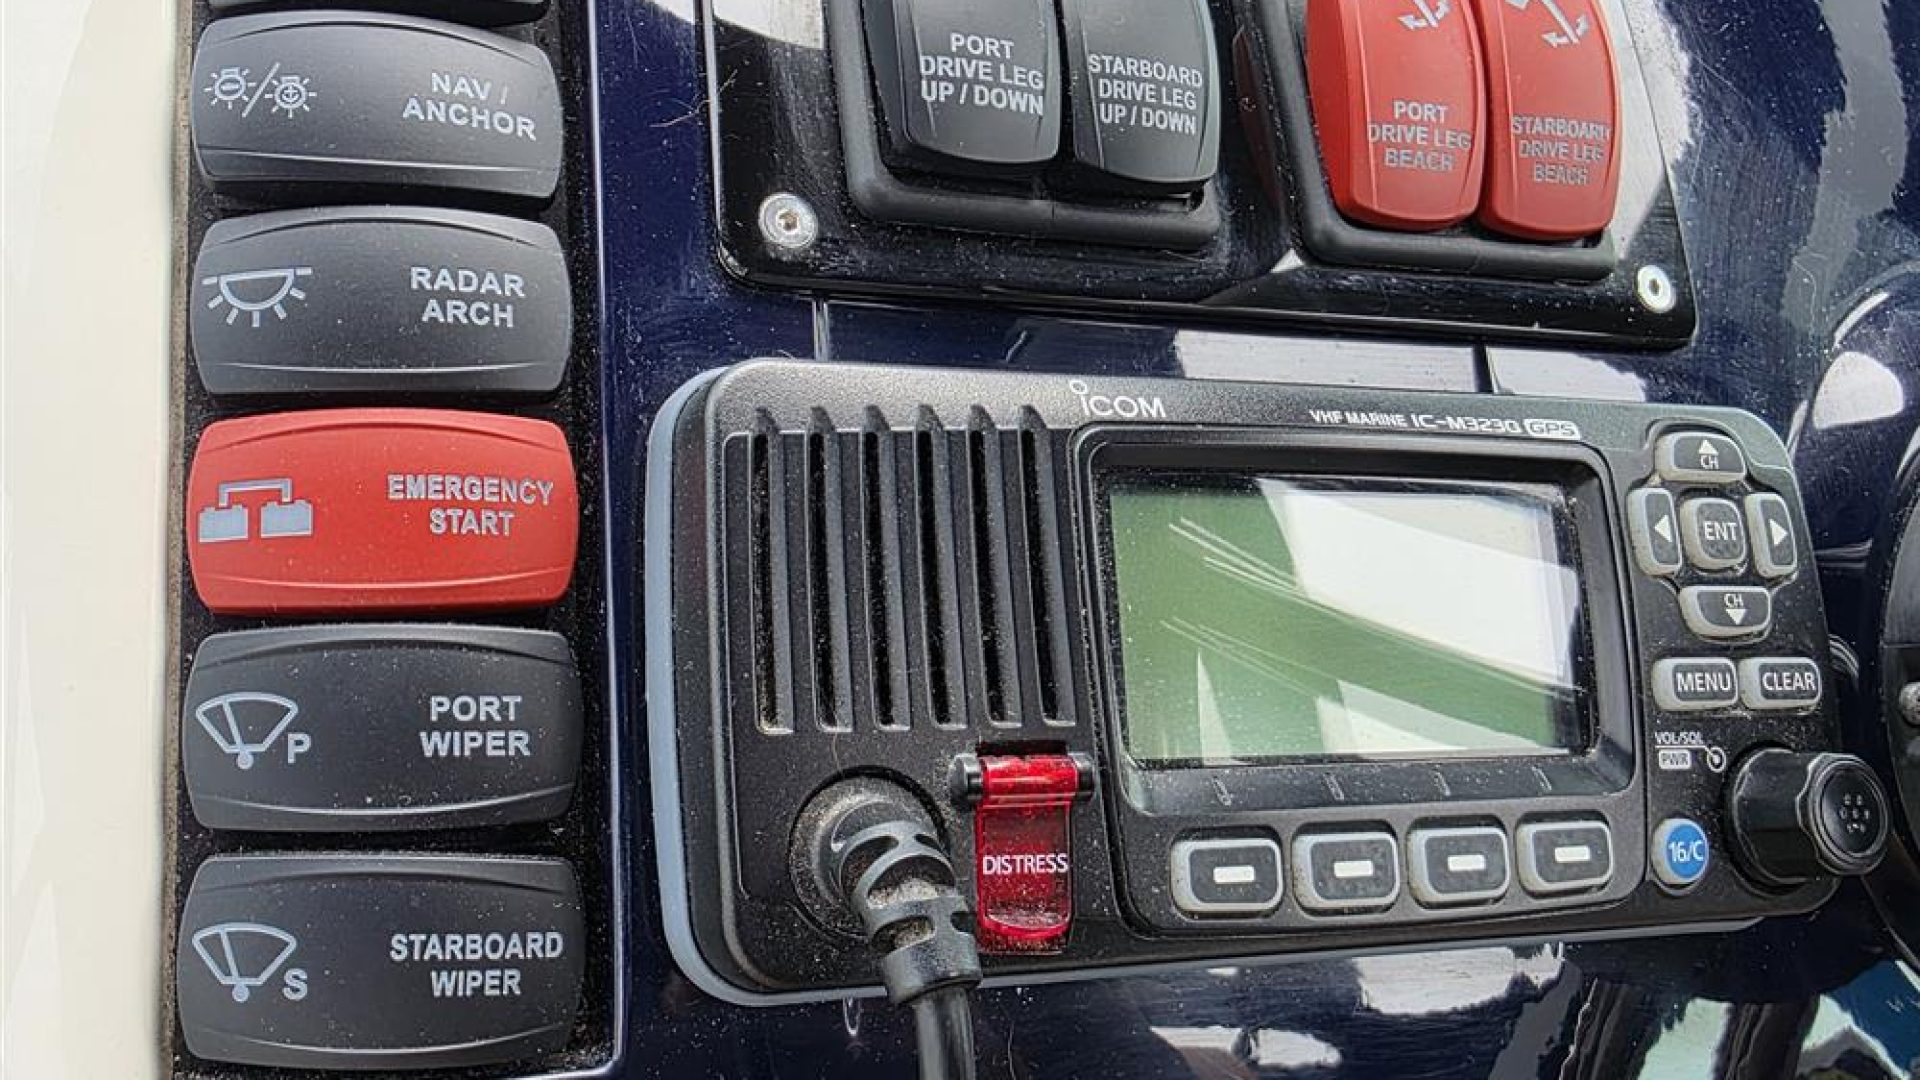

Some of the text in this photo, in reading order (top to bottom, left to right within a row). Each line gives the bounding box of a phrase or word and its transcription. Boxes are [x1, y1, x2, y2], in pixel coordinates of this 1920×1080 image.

[951, 33, 1014, 60] PORT
[919, 55, 1044, 90] DRIVE LEG
[1088, 53, 1202, 88] STARBOARD
[431, 72, 491, 99] NAV
[921, 80, 1044, 116] UP / DOWN
[1099, 78, 1197, 110] DRIVE LEG
[402, 98, 537, 141] ANCHOR
[1100, 103, 1196, 136] UP / DOWN
[1393, 101, 1448, 123] PORT
[1367, 124, 1472, 150] DRIVE LEG
[1511, 115, 1612, 142] STARBOARD
[1384, 149, 1455, 172] BEACH
[1519, 140, 1605, 161] DRIVE LEG
[1534, 165, 1589, 185] BEACH
[410, 266, 525, 297] RADAR
[422, 299, 514, 328] ARCH
[1309, 409, 1579, 438] VHF MARINE IC-M3230 GPS
[1700, 454, 1719, 469] CH
[388, 474, 554, 506] EMERGENCY
[430, 508, 514, 537] START
[1704, 520, 1738, 541] ENT
[1724, 593, 1743, 608] CH
[1675, 673, 1731, 691] MENU
[1762, 672, 1816, 691] CLEAR
[430, 696, 522, 722] PORT
[287, 733, 311, 764] P
[420, 731, 531, 757] WIPER
[1654, 731, 1703, 745] VOL/SQL
[1661, 752, 1689, 767] PWR
[982, 854, 1069, 875] DISTRESS
[1668, 840, 1704, 863] 16/C
[390, 932, 564, 961] STARBOARD
[283, 968, 308, 1000] S
[431, 969, 521, 996] WIPER
